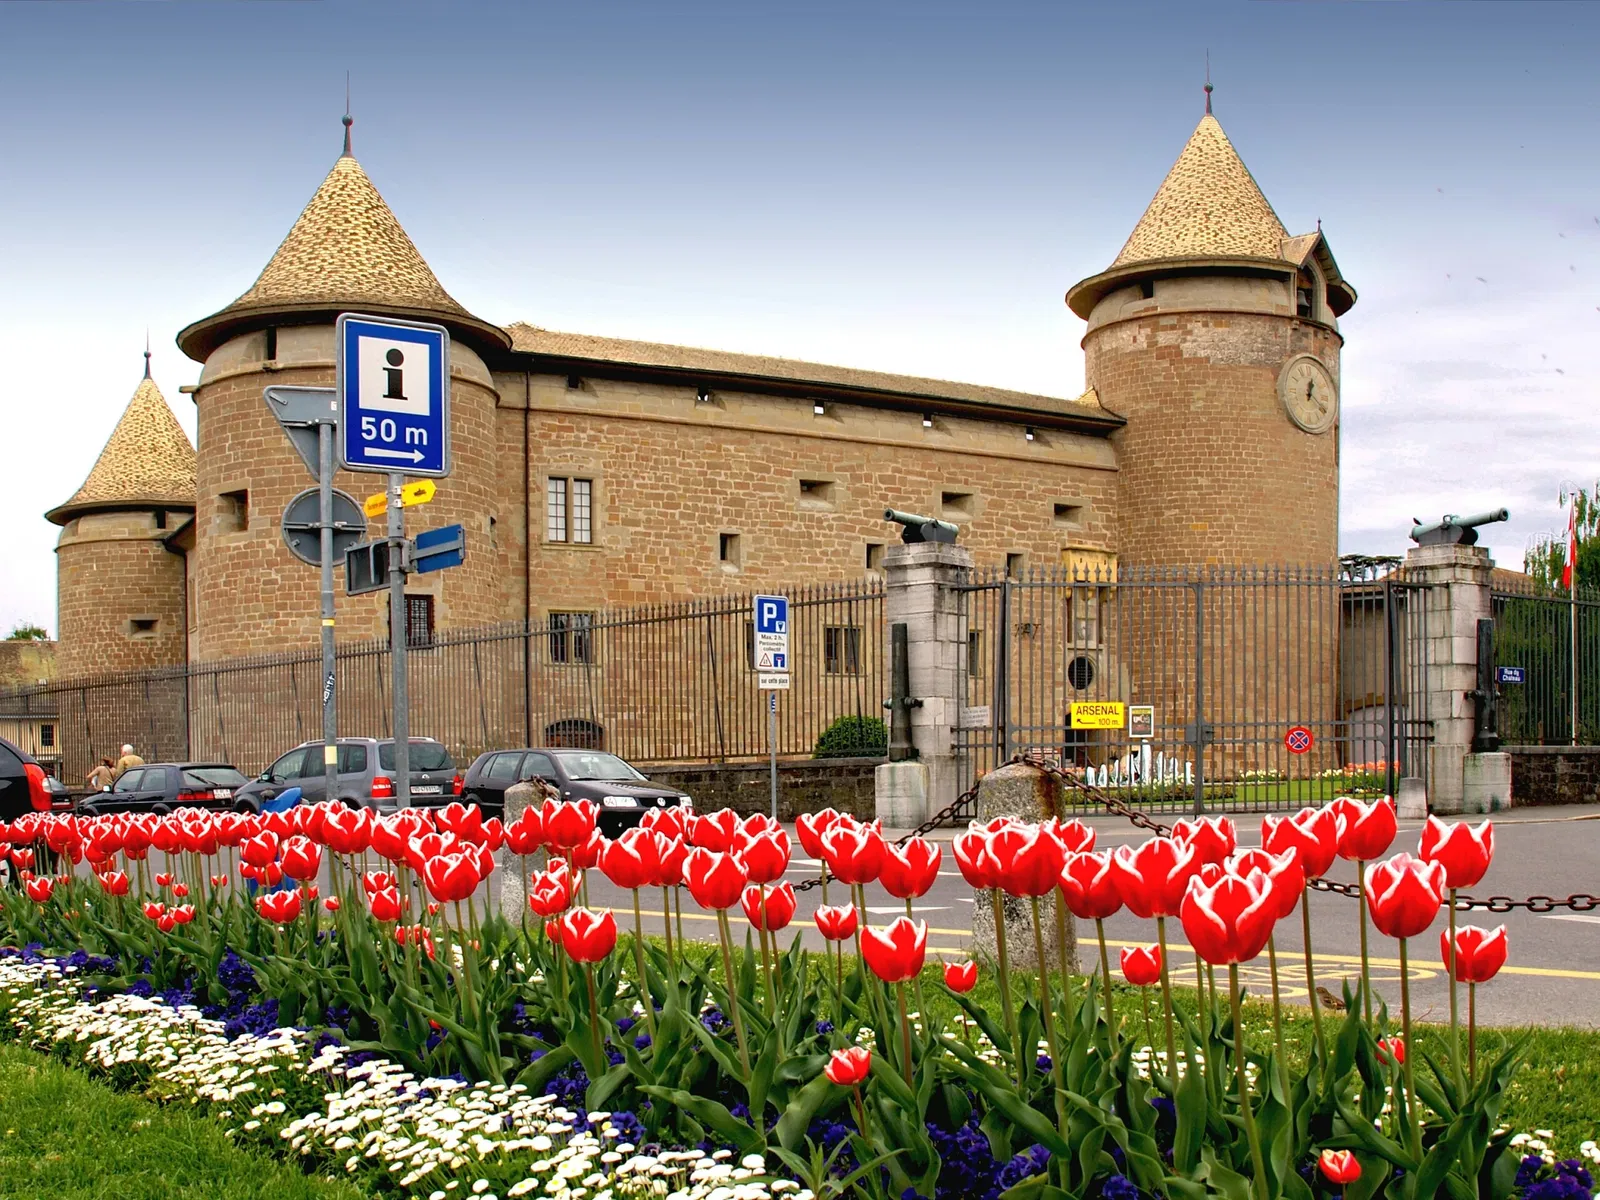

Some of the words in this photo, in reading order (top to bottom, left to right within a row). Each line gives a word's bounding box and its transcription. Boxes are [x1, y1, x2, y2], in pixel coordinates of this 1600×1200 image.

[382, 348, 408, 400] i
[361, 416, 397, 442] 50
[405, 427, 428, 446] m
[763, 602, 777, 627] P
[1076, 705, 1120, 715] ARSENAL
[1098, 718, 1111, 726] 100
